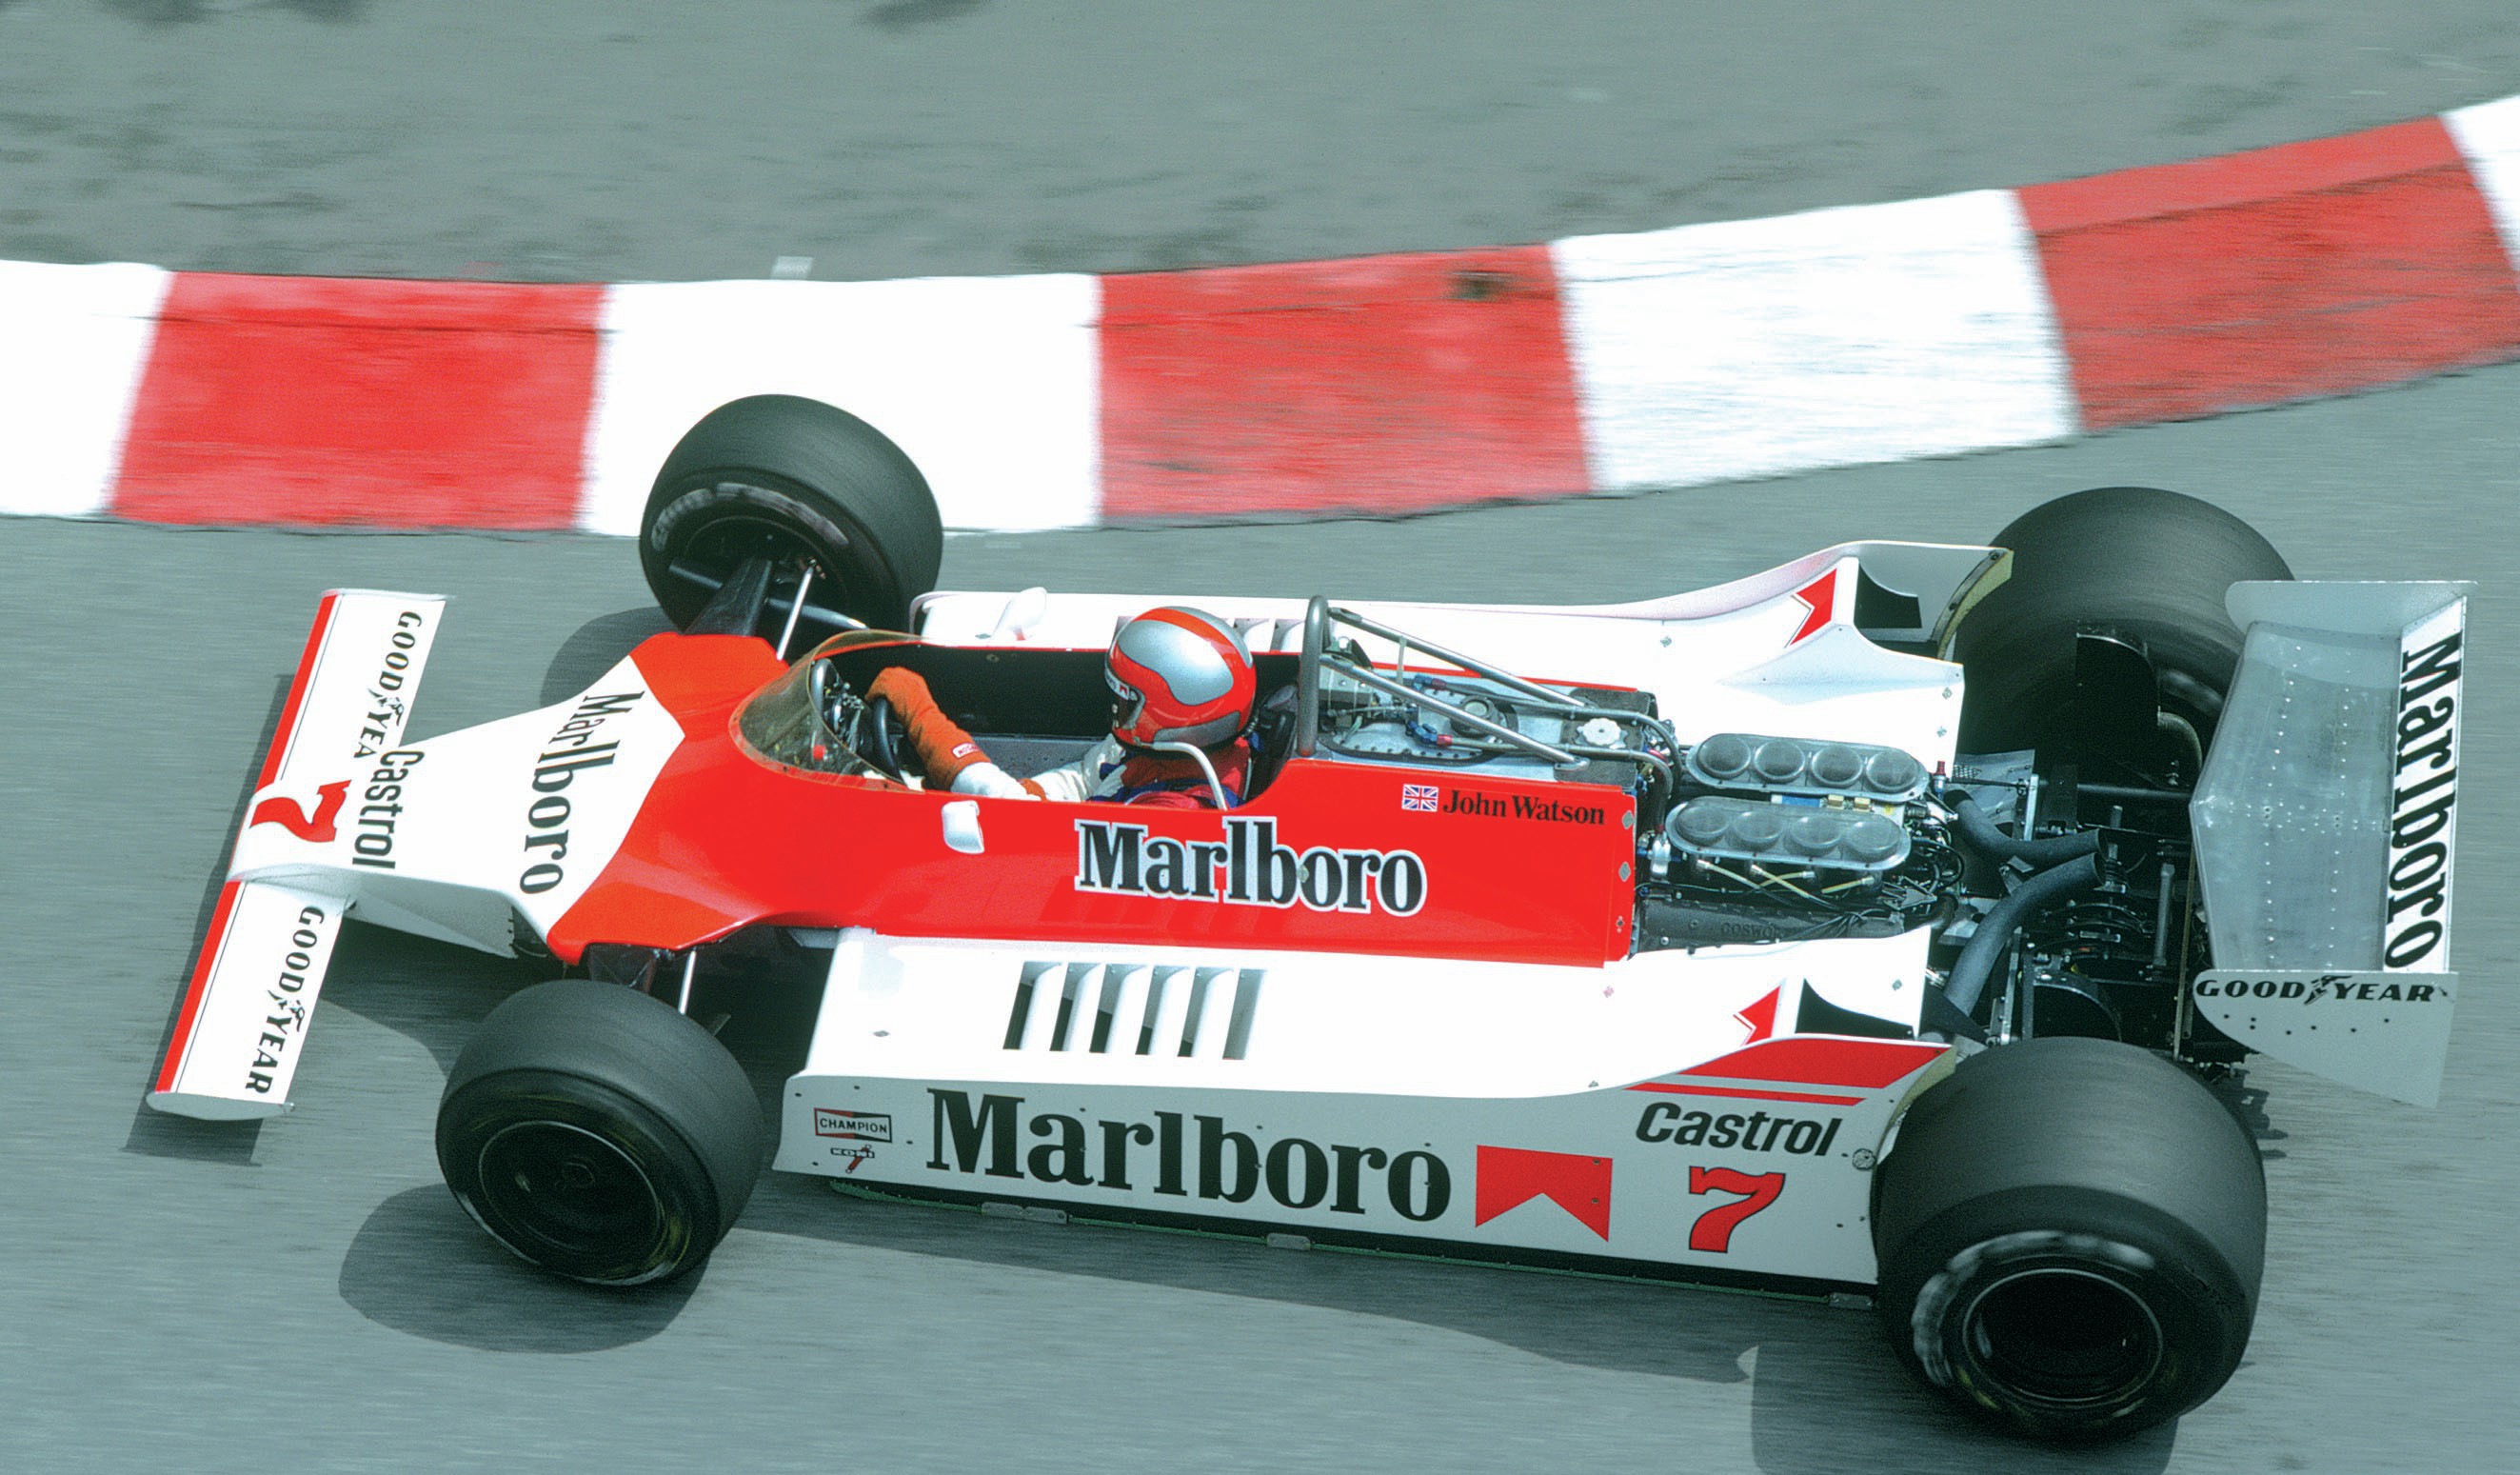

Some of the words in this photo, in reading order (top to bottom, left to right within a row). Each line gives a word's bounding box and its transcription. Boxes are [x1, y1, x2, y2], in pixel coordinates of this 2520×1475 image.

[353, 610, 423, 759] GOODYEA
[249, 779, 353, 843] 7
[351, 750, 426, 869] Castrol
[519, 690, 645, 895] Marlboro
[1443, 789, 1507, 818] John
[1512, 794, 1605, 826] Watson
[2384, 631, 2464, 969] Marlboro
[1076, 816, 1427, 916] Marlboro
[246, 906, 326, 1095] GOODYEAR
[2195, 974, 2436, 1006] GOODYEAR
[819, 1117, 888, 1134] CHAMPION
[925, 1086, 1452, 1223] Marlboro
[1635, 1101, 1844, 1157] Castrol
[1688, 1165, 1787, 1254] 7
